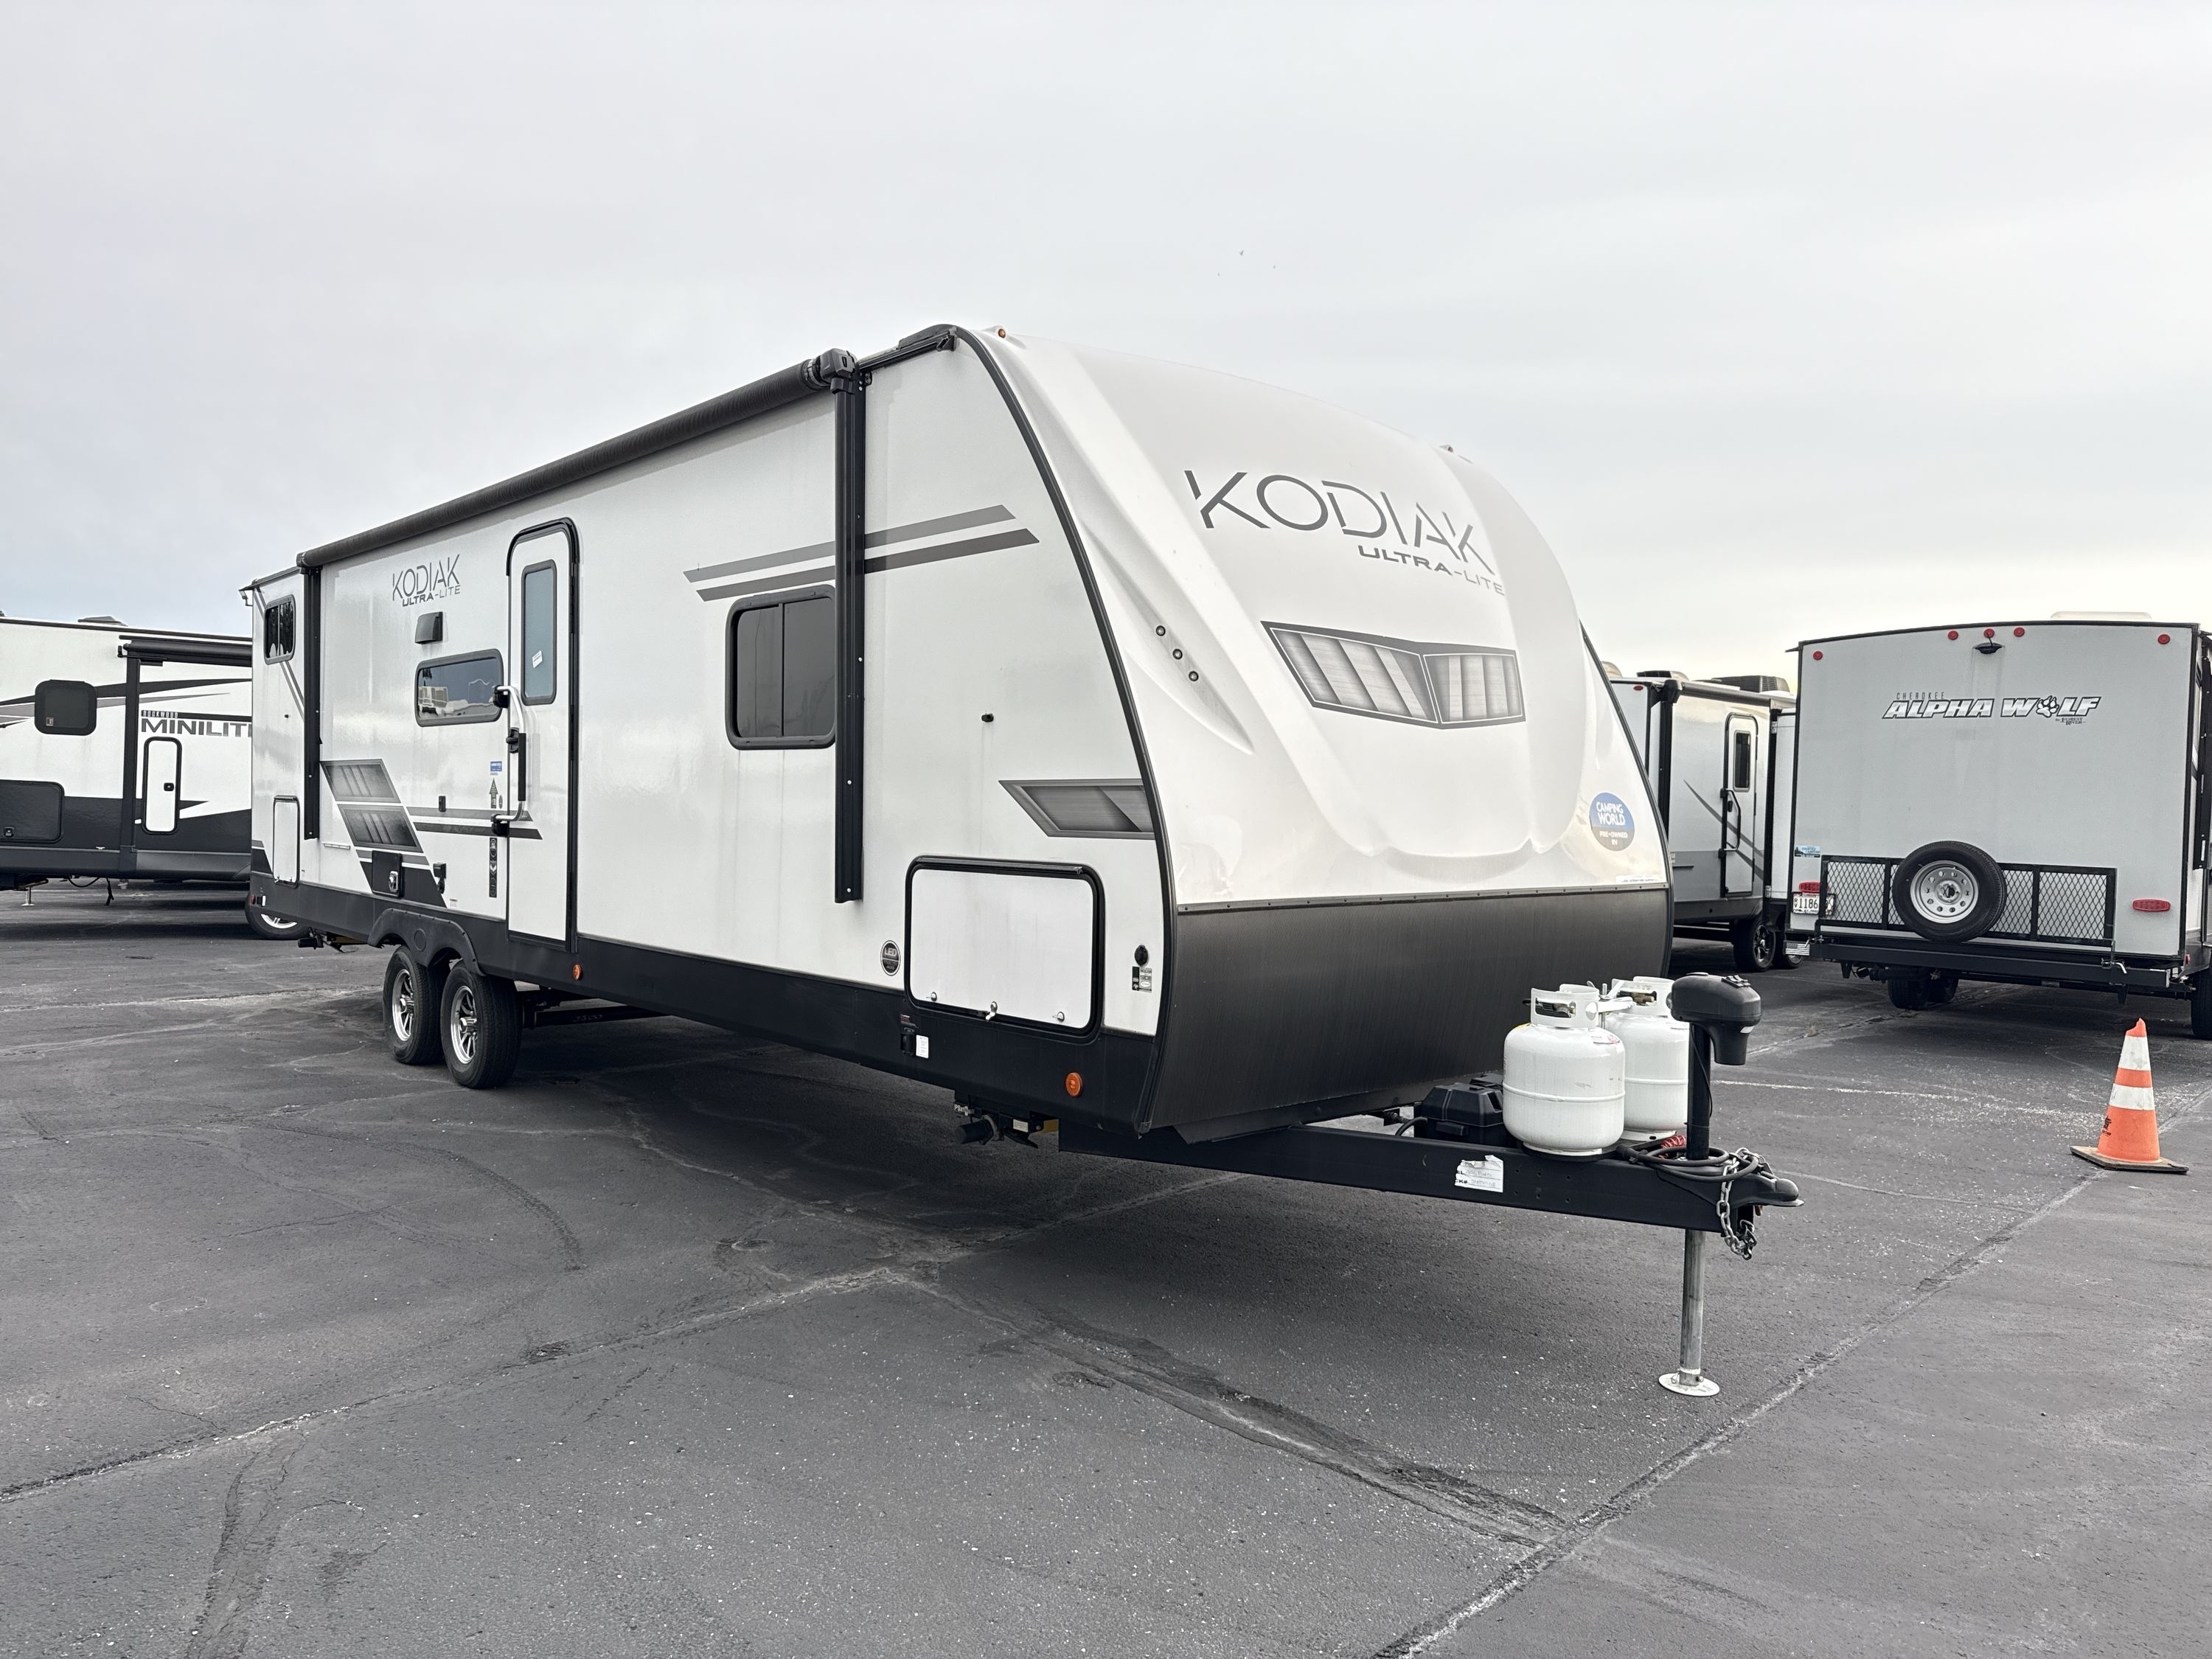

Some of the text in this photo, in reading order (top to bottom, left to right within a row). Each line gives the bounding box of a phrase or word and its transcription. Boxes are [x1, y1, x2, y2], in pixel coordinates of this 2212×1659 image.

[1184, 470, 1495, 575] KODIAK
[392, 554, 460, 601] KODIAK
[1357, 545, 1506, 596] ULTRA-LITE
[402, 585, 461, 607] ULTRA-LITE
[1896, 691, 1945, 700] CHEROKEE
[142, 710, 178, 719] ROCKWOOD
[1882, 698, 1994, 719] ALPHA
[141, 718, 252, 737] MINILIT
[1596, 801, 1624, 815] CAMPING
[1598, 812, 1626, 826] WORLD
[1599, 830, 1628, 838] PRE-OWNED
[884, 947, 897, 957] LED
